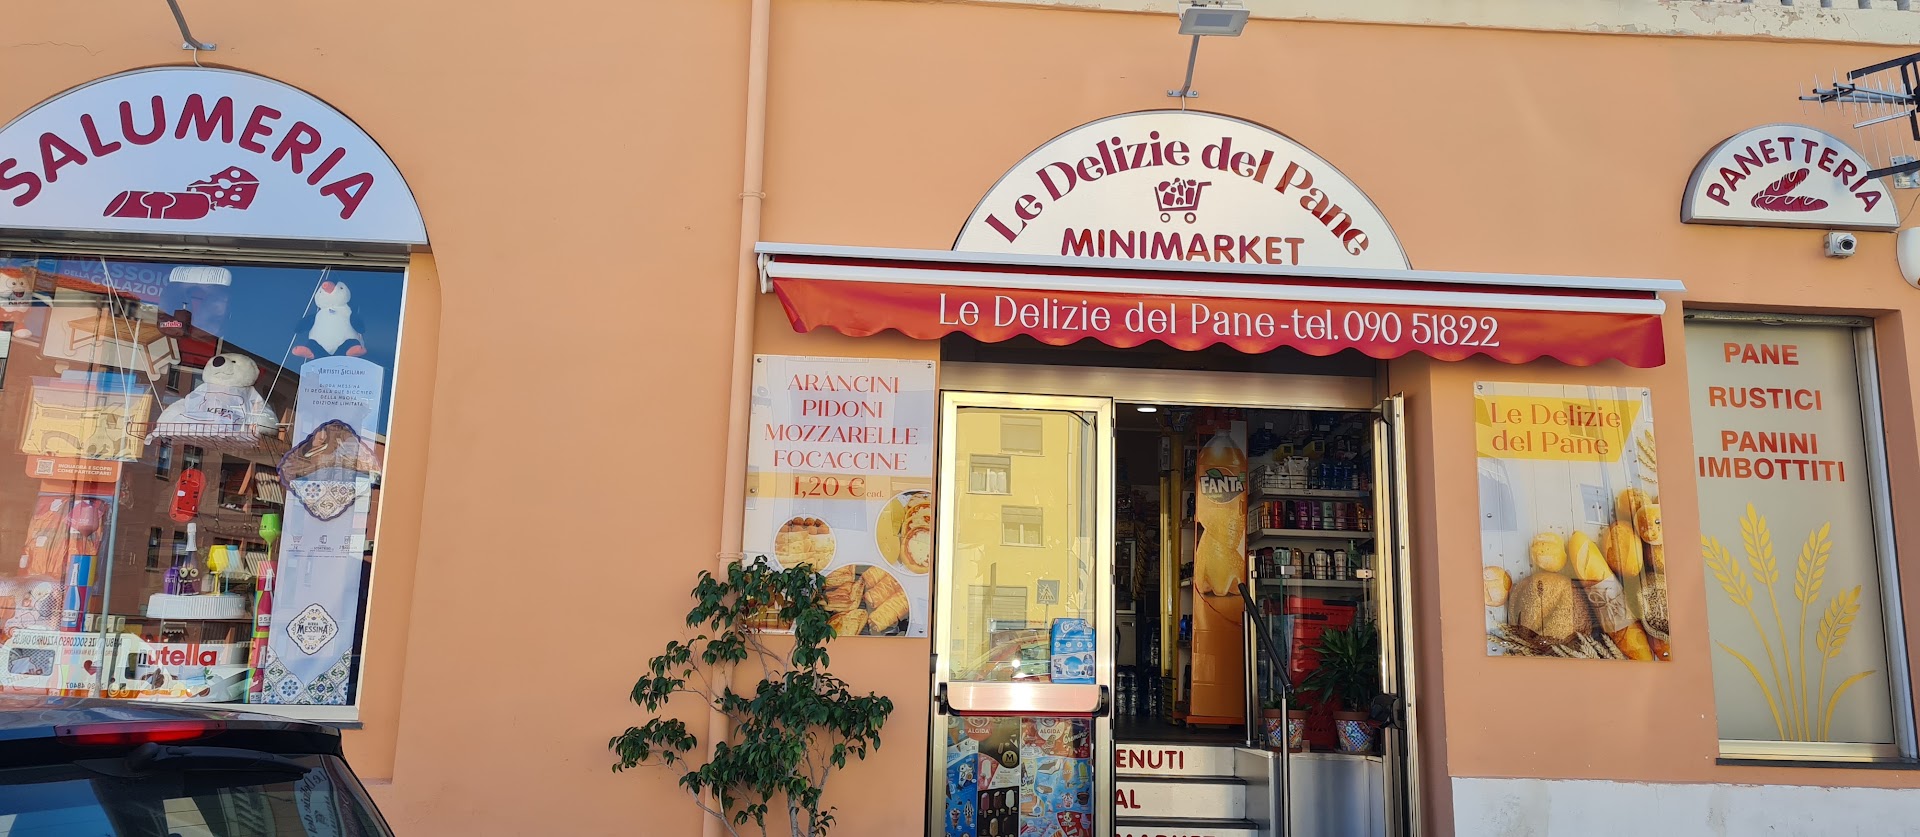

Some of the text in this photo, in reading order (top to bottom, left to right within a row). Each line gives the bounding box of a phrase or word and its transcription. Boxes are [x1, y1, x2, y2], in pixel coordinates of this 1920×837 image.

[0, 93, 374, 220] SALUMERIA
[1706, 136, 1882, 213] PANETTERIA
[984, 130, 1370, 256] Le Delizie del Pane
[1061, 227, 1305, 266] MINIMARKET
[64, 268, 90, 279] DELLA
[160, 320, 182, 328] nutella
[939, 293, 980, 326] Le
[994, 295, 1111, 331] Delizie
[1125, 301, 1177, 334] del
[1411, 312, 1501, 347] 51822
[1723, 342, 1800, 366] PANE
[787, 373, 900, 394] ARANCINI
[802, 399, 883, 419] PIDONI
[1708, 386, 1823, 411] RUSTICI
[1491, 402, 1621, 428] Le Delizie
[764, 423, 919, 445] MOZZARELLE
[1492, 429, 1609, 455] del Pane
[1720, 430, 1818, 455] PANINI
[773, 449, 908, 471] FOCACCINE
[1698, 456, 1846, 482] IMBOTTITI
[793, 476, 840, 498] 1,20
[846, 477, 866, 498] €
[1200, 476, 1244, 494] FANTA
[296, 624, 329, 635] MESSINA
[138, 643, 218, 667] nutella
